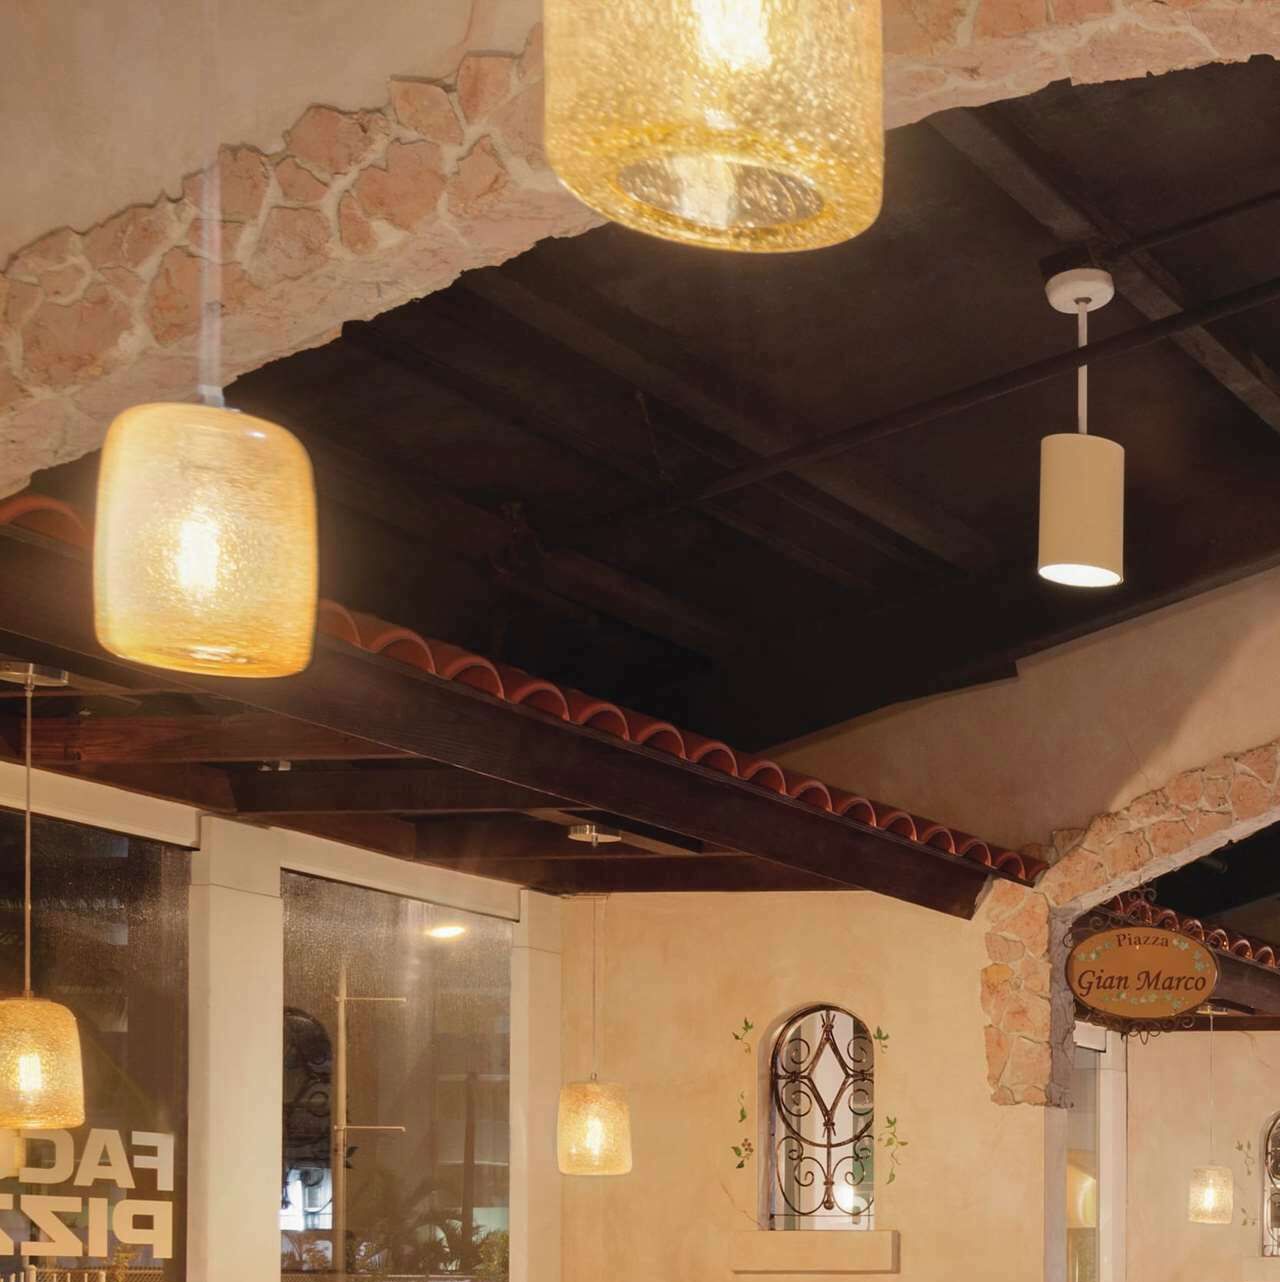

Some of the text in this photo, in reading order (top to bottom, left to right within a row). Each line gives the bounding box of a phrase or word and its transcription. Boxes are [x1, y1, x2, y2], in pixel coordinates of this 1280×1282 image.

[1115, 933, 1169, 948] Piazza
[1077, 969, 1207, 997] Gian Marco
